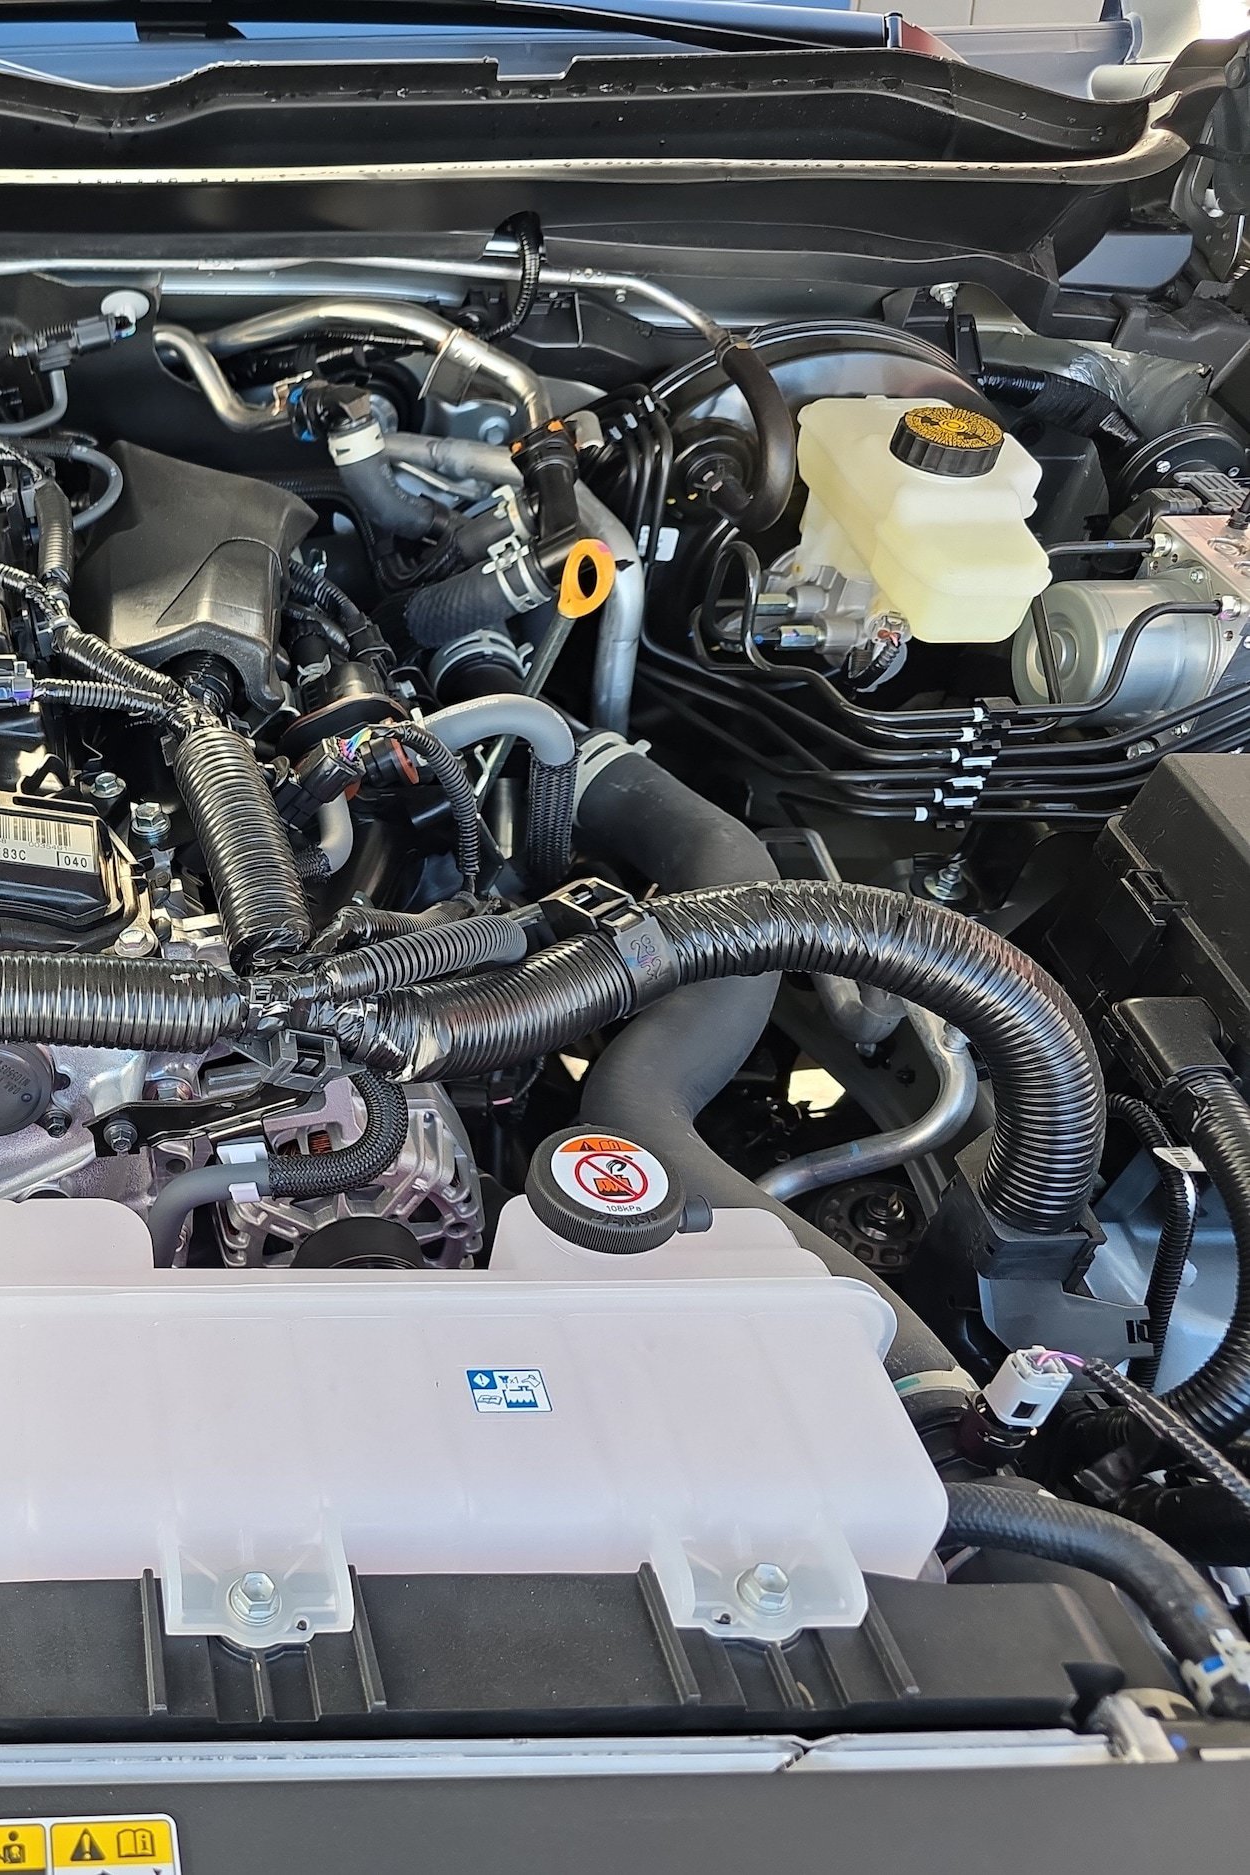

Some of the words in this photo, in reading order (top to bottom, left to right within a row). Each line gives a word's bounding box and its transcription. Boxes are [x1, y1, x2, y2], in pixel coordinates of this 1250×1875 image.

[63, 855, 89, 869] 040
[605, 1204, 642, 1213] 108kPa
[590, 1212, 661, 1228] DENSO
